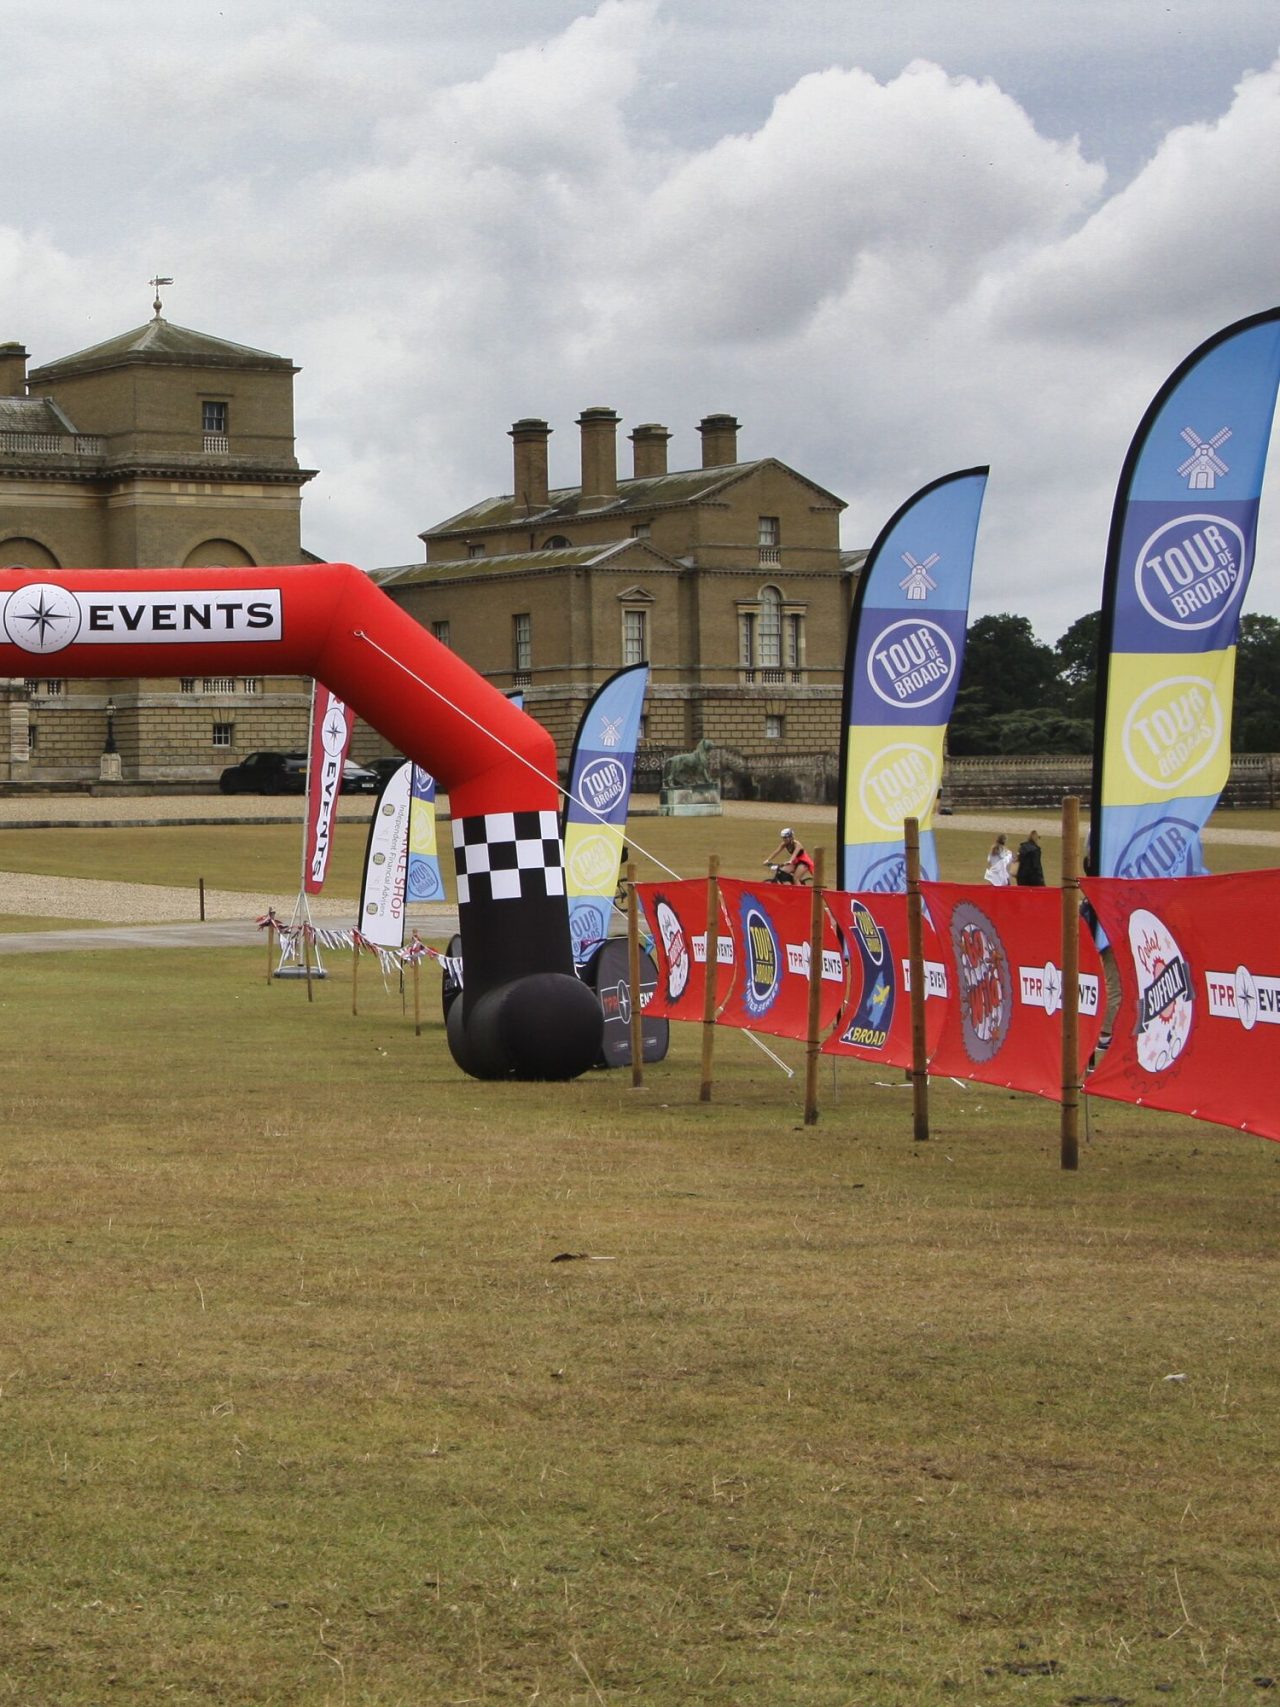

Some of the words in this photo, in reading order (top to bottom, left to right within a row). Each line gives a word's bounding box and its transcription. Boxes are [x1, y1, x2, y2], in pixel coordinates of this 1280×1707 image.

[1145, 525, 1227, 595] TOUR
[1219, 549, 1234, 570] DE
[1170, 562, 1238, 619] BROADS
[88, 602, 274, 632] EVENTS
[875, 627, 935, 681] TOUR
[928, 645, 940, 662] DE
[893, 657, 949, 700] BROADS
[584, 763, 618, 796] TOUR
[593, 782, 622, 807] BROADS
[867, 751, 926, 805] TOUR
[312, 761, 337, 877] EVENTS
[389, 877, 406, 920] SHOP
[788, 951, 803, 968] TPR
[824, 957, 842, 974] ENTS
[1137, 929, 1162, 974] Pedal
[1022, 976, 1043, 998] TPR
[1148, 962, 1184, 1017] SUFFOLK
[1210, 983, 1236, 1008] TPR
[843, 1027, 886, 1046] ABROAD
